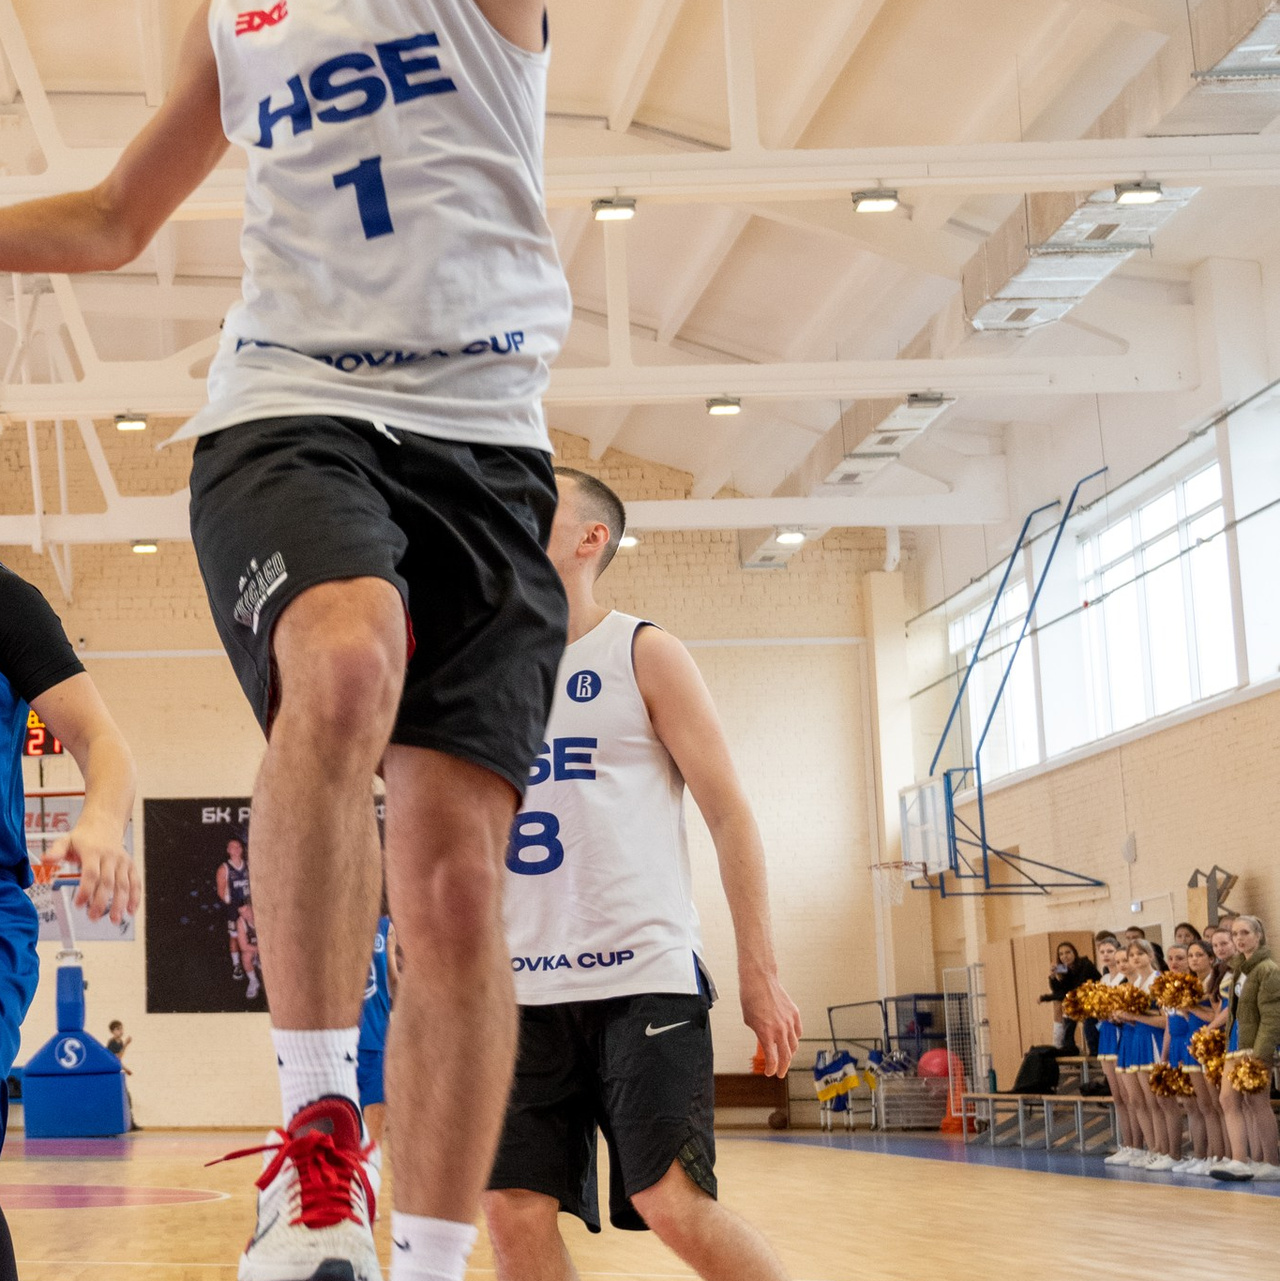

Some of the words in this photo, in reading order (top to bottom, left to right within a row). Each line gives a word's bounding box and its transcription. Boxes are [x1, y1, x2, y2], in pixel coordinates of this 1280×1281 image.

[254, 32, 458, 149] HSE
[333, 156, 395, 240] 1
[526, 737, 598, 786] SE
[201, 807, 231, 824] БК
[507, 811, 565, 876] 8
[577, 949, 634, 968] CUP
[60, 1038, 81, 1069] S
